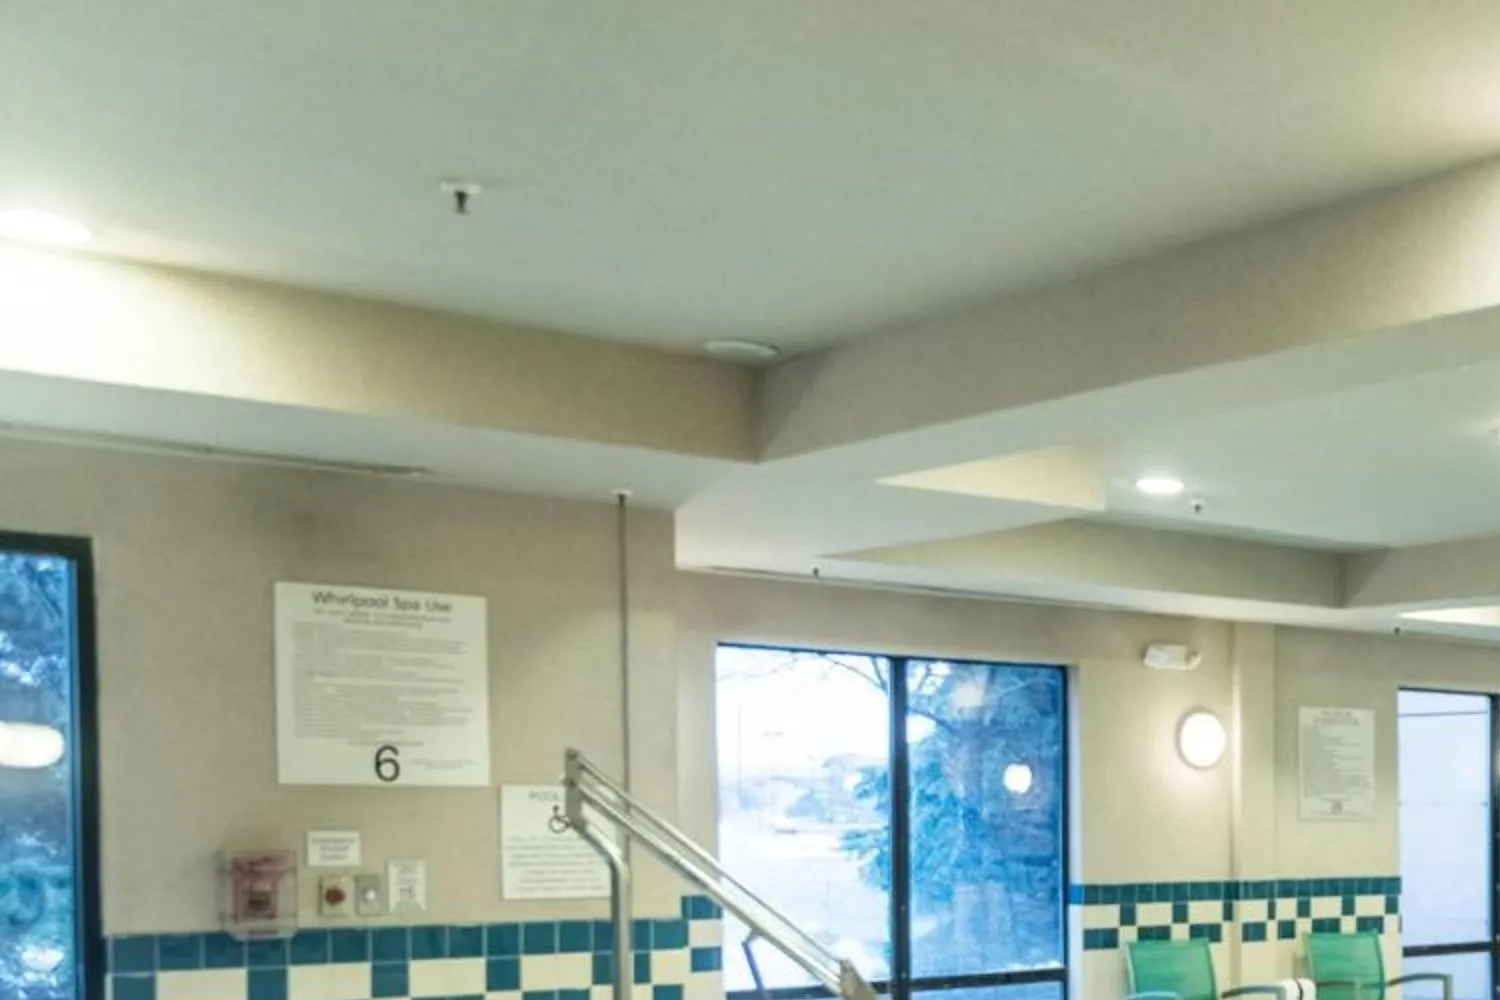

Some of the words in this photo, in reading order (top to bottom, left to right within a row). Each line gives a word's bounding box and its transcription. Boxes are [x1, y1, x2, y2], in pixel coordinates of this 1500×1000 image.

[312, 591, 390, 608] Whirlpool
[393, 595, 421, 612] Spa
[426, 599, 453, 613] Use
[374, 745, 400, 782] 6
